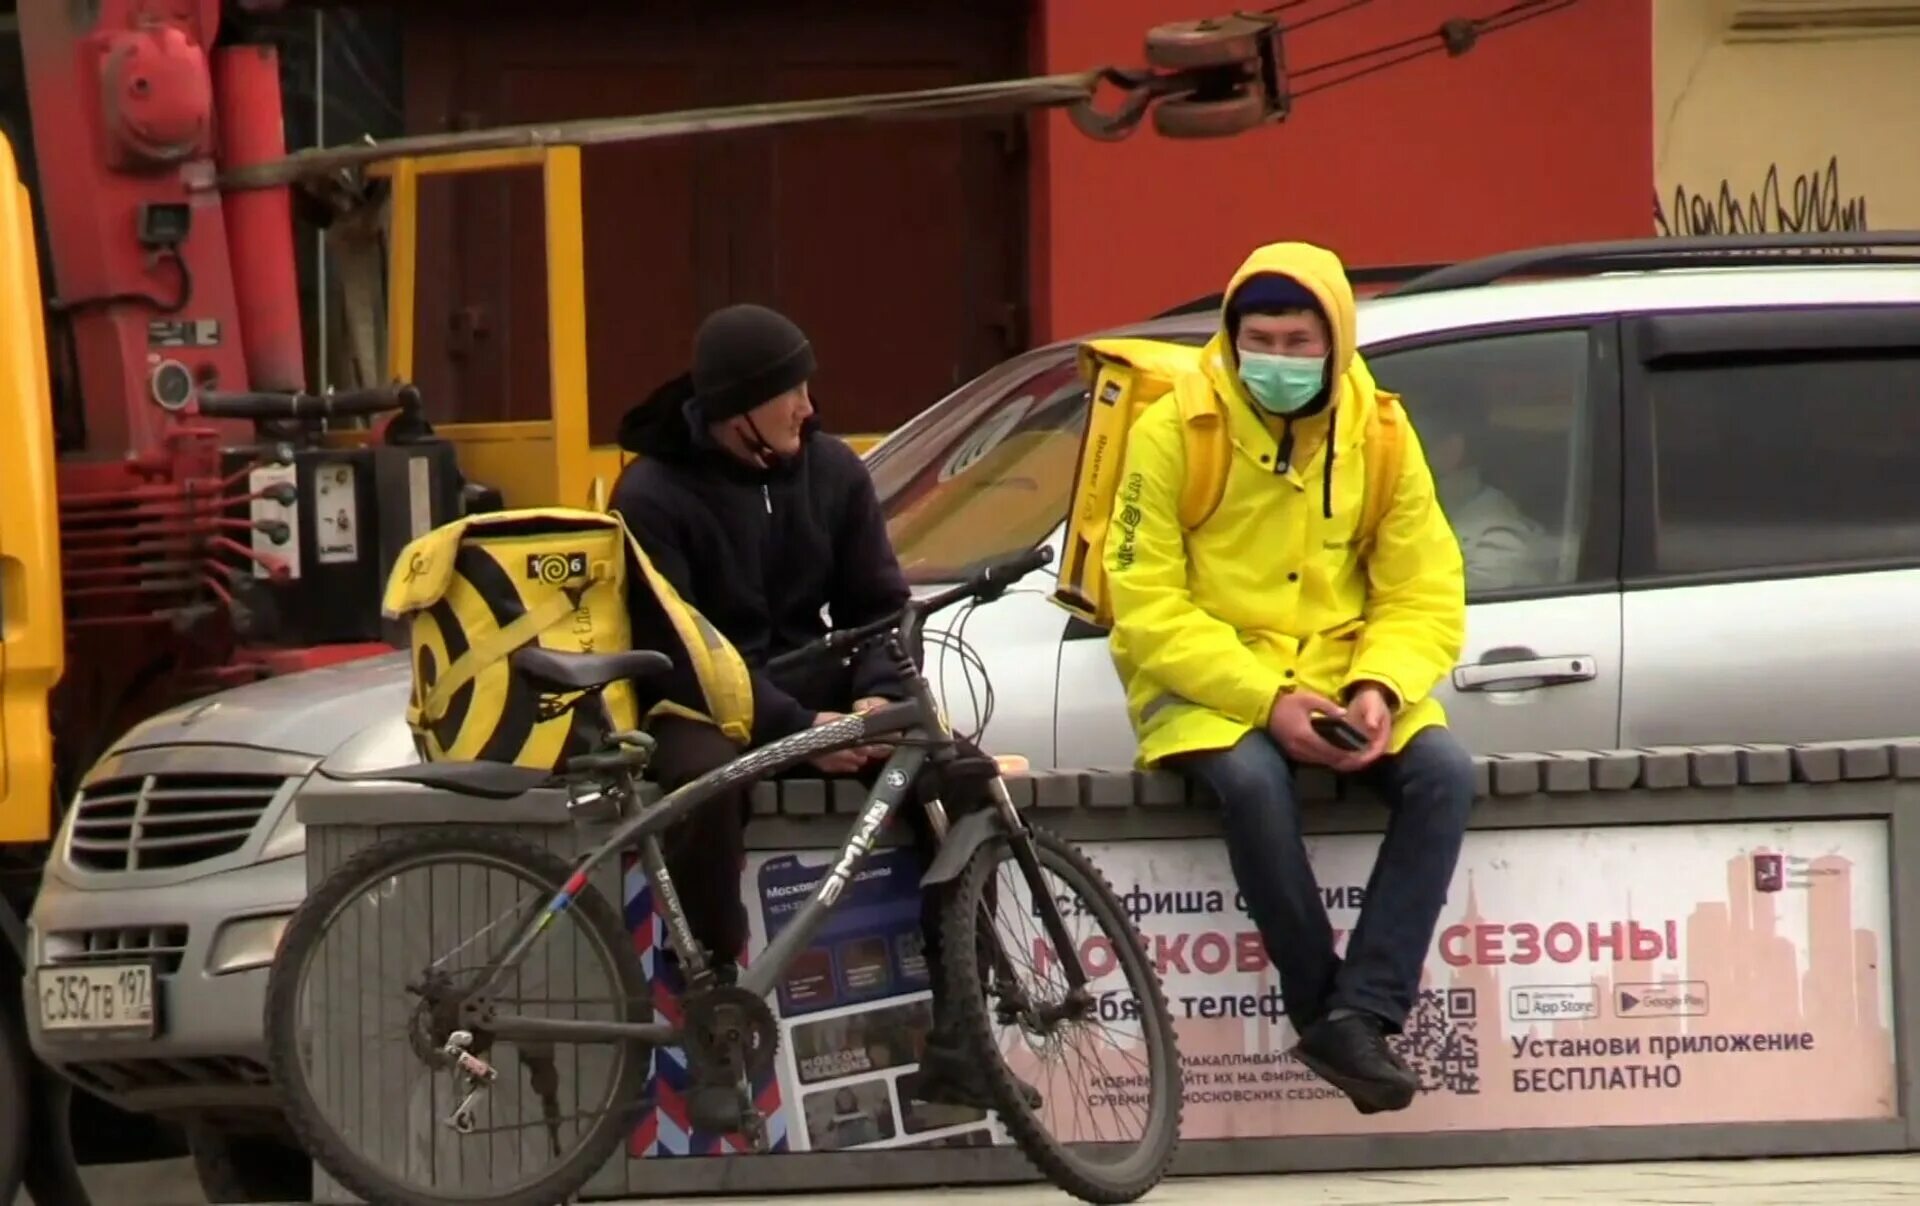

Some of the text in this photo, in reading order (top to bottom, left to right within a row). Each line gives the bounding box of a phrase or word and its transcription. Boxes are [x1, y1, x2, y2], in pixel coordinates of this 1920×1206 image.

[1118, 884, 1223, 922] фиша
[1439, 920, 1678, 966] СЕЗОНЫ
[118, 969, 147, 1004] 197
[1179, 985, 1287, 1024] телеф
[1533, 1000, 1594, 1014] App Store
[1512, 1031, 1815, 1060] Установи приложение
[1214, 1072, 1233, 1085] ИХ
[1238, 1071, 1258, 1083] НА
[1513, 1064, 1682, 1093] БЕСПЛАТНО
[1287, 1087, 1346, 1100] СЕЗОНО
